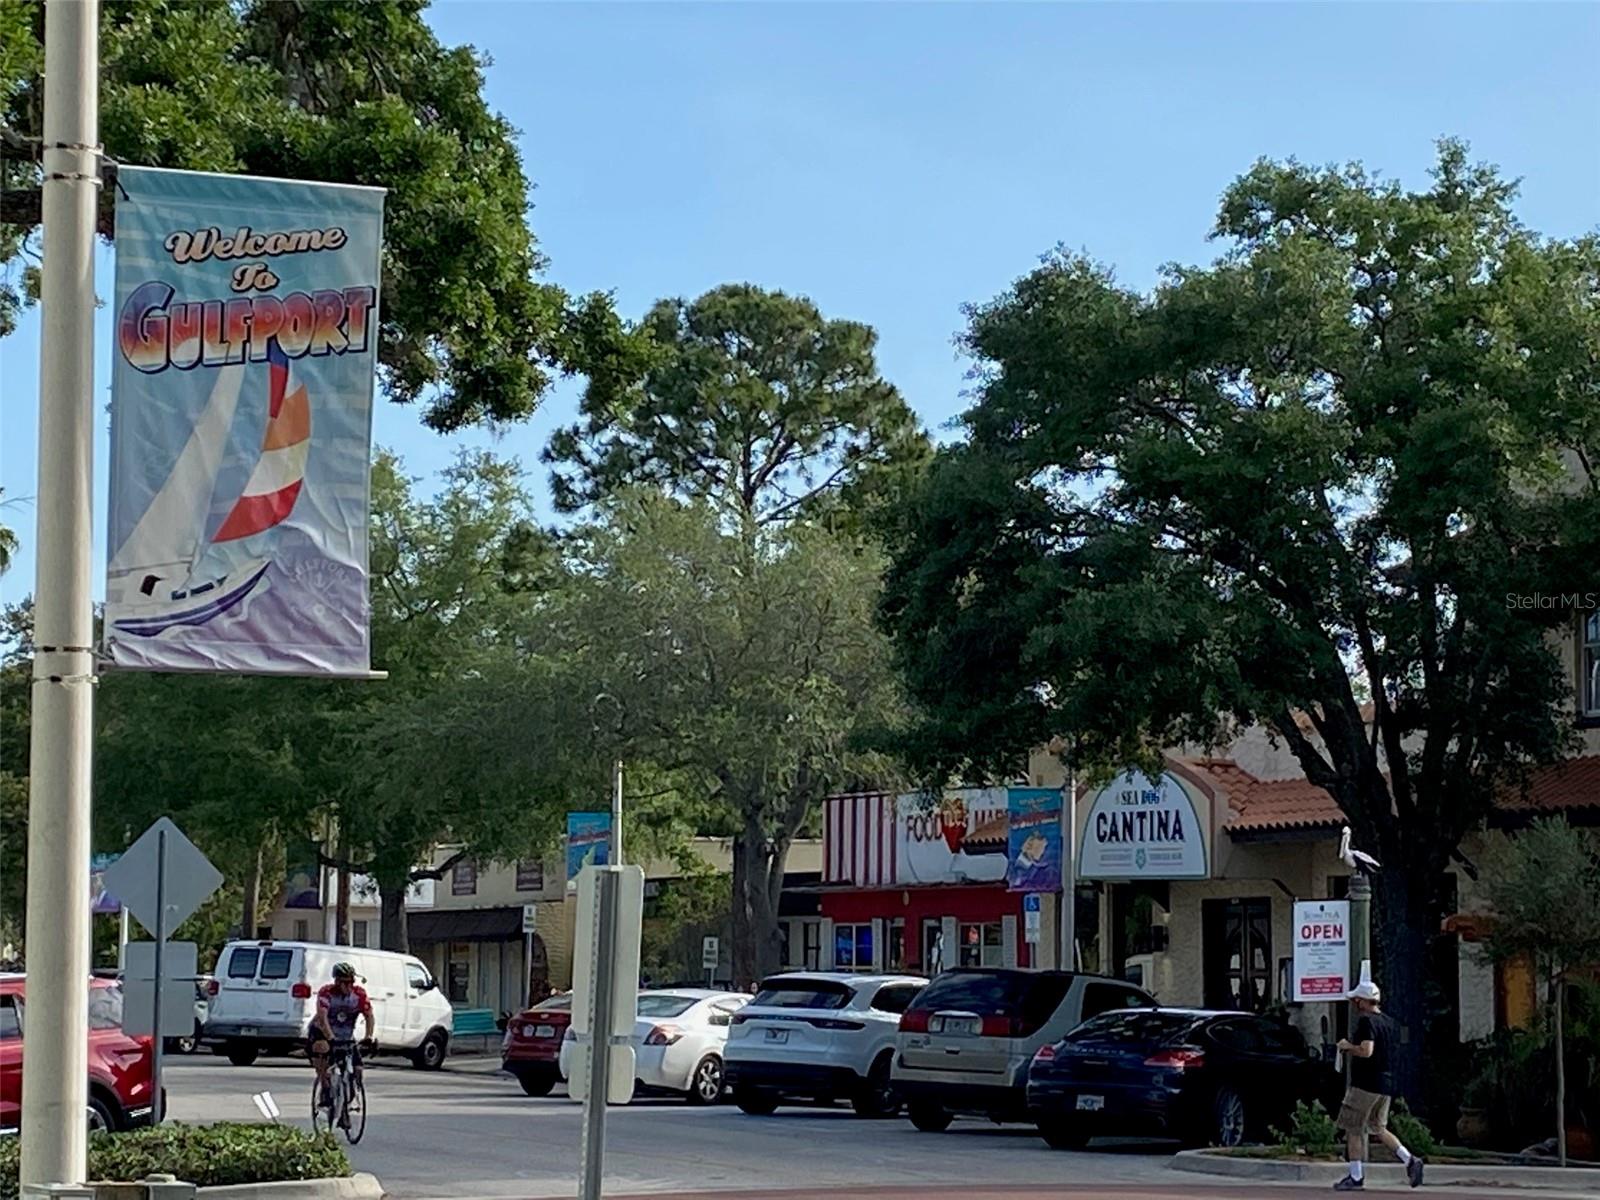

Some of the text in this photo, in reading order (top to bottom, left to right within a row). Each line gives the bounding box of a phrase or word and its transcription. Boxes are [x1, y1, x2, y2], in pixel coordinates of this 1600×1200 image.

[164, 227, 348, 263] Welcome
[230, 262, 280, 292] To
[119, 281, 376, 373] GULFPORT
[906, 813, 942, 843] FOOD
[1096, 808, 1186, 843] CANTINA
[1301, 923, 1344, 940] OPEN
